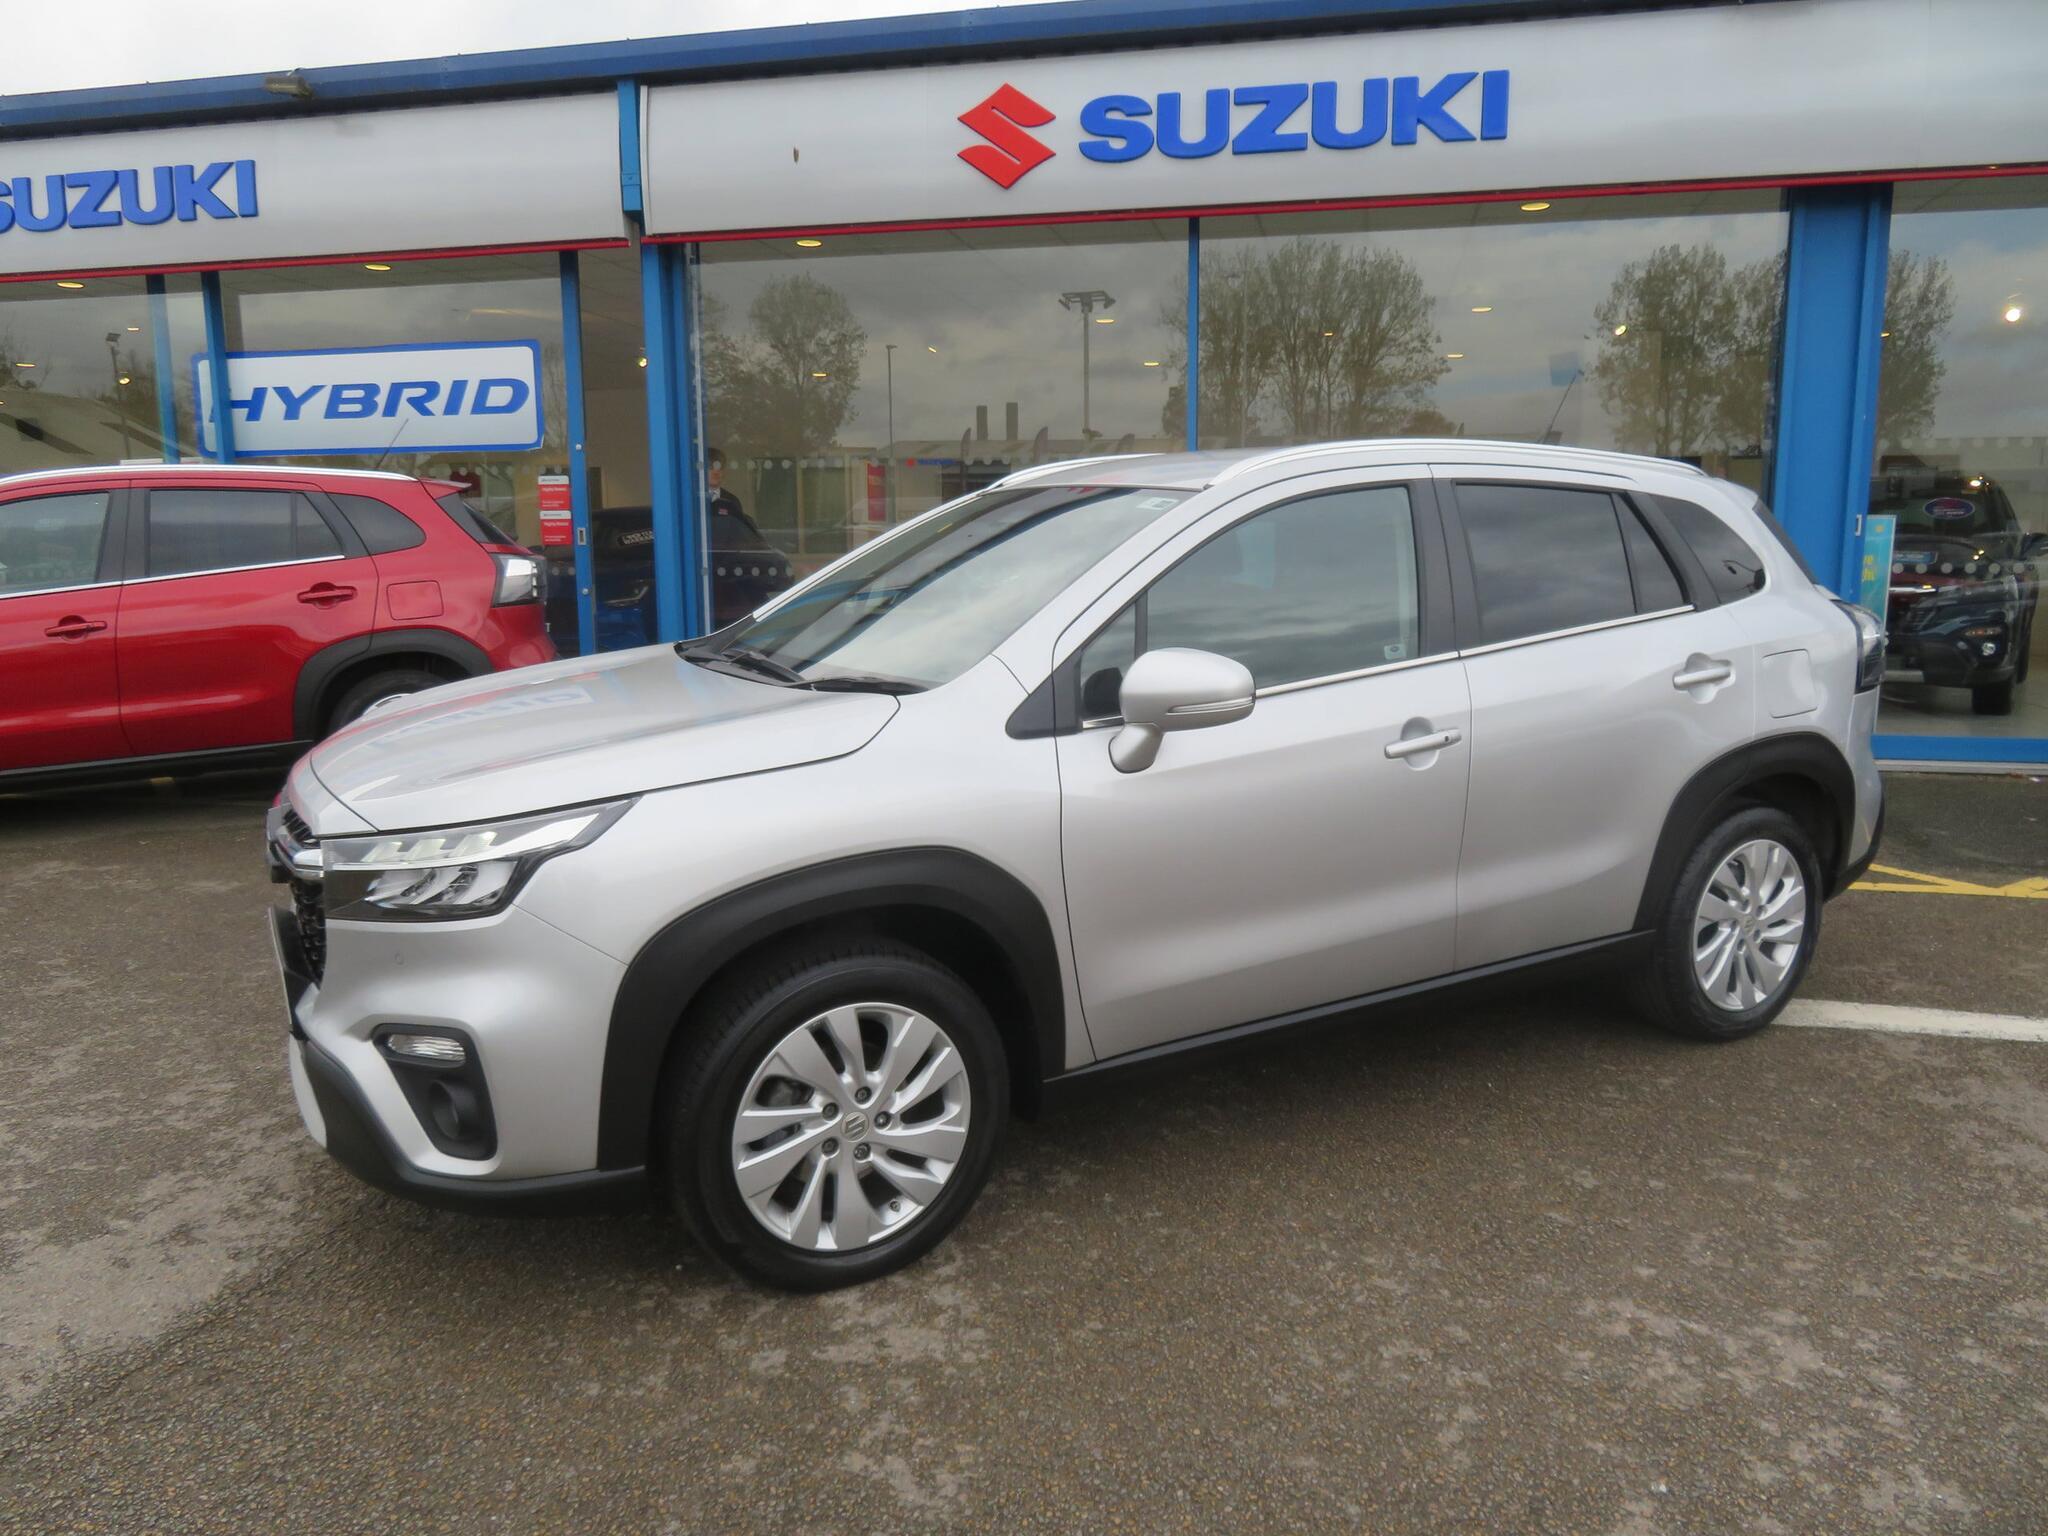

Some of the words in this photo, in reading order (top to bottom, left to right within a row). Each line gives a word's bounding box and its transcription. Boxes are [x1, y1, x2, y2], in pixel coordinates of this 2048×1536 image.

[1079, 70, 1510, 163] SUZUKI
[0, 160, 259, 234] UZUKI
[208, 378, 530, 423] HYBRID
